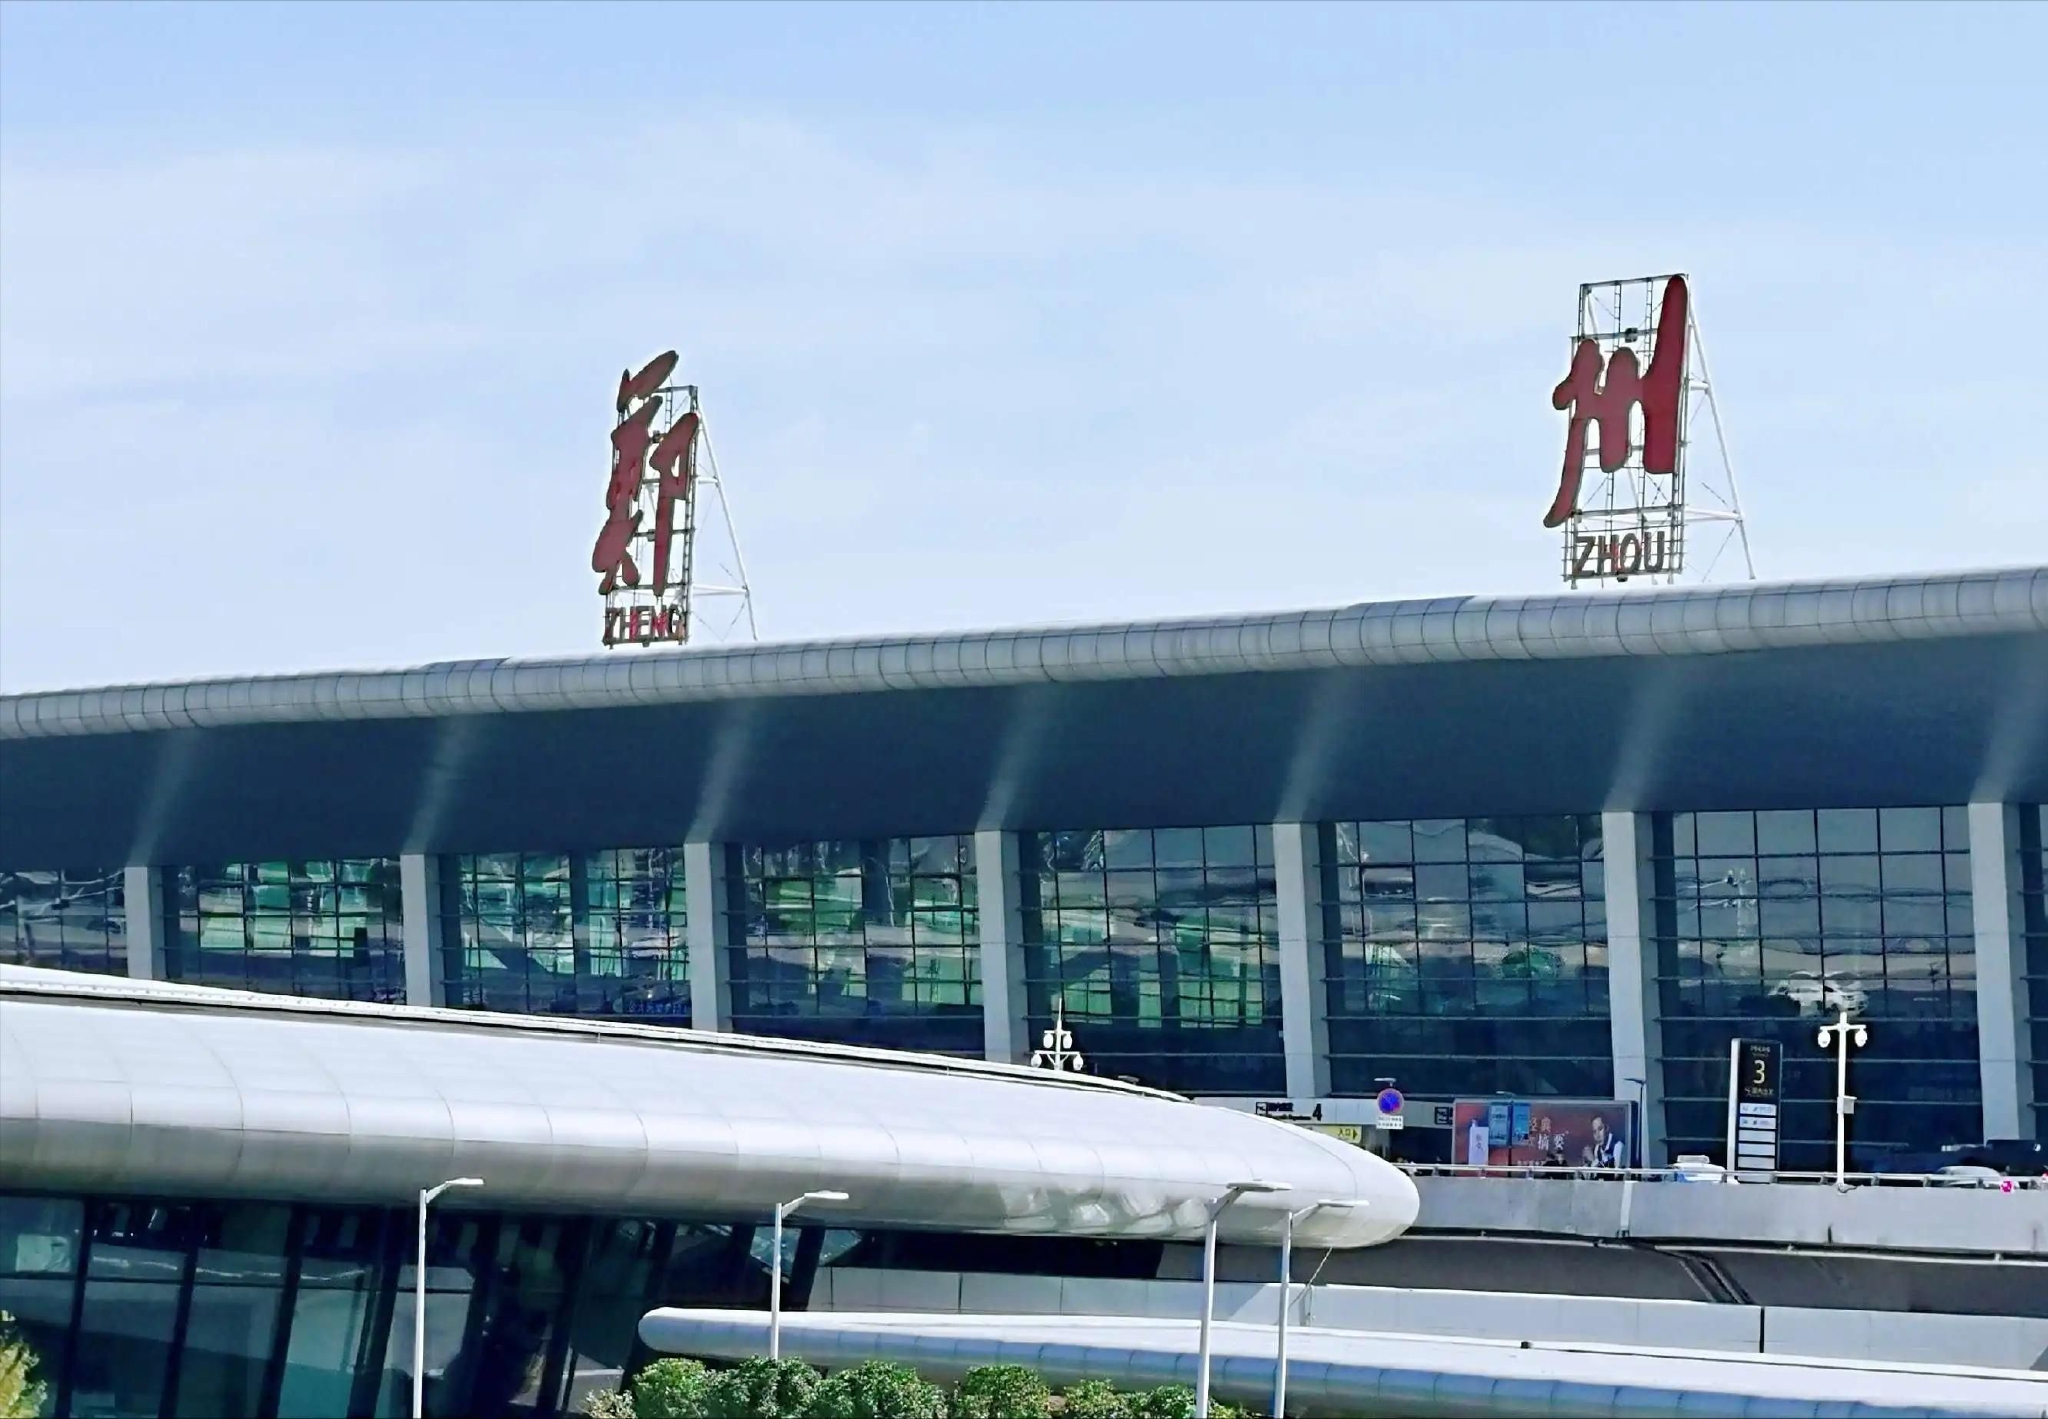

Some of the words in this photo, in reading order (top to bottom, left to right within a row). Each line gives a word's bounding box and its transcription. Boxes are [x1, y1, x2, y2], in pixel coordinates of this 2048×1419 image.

[1543, 274, 1689, 528] 州
[1573, 531, 1666, 576] ZHOU
[605, 606, 685, 640] ZHENG
[1753, 1059, 1766, 1084] 3
[1312, 1103, 1323, 1122] 4
